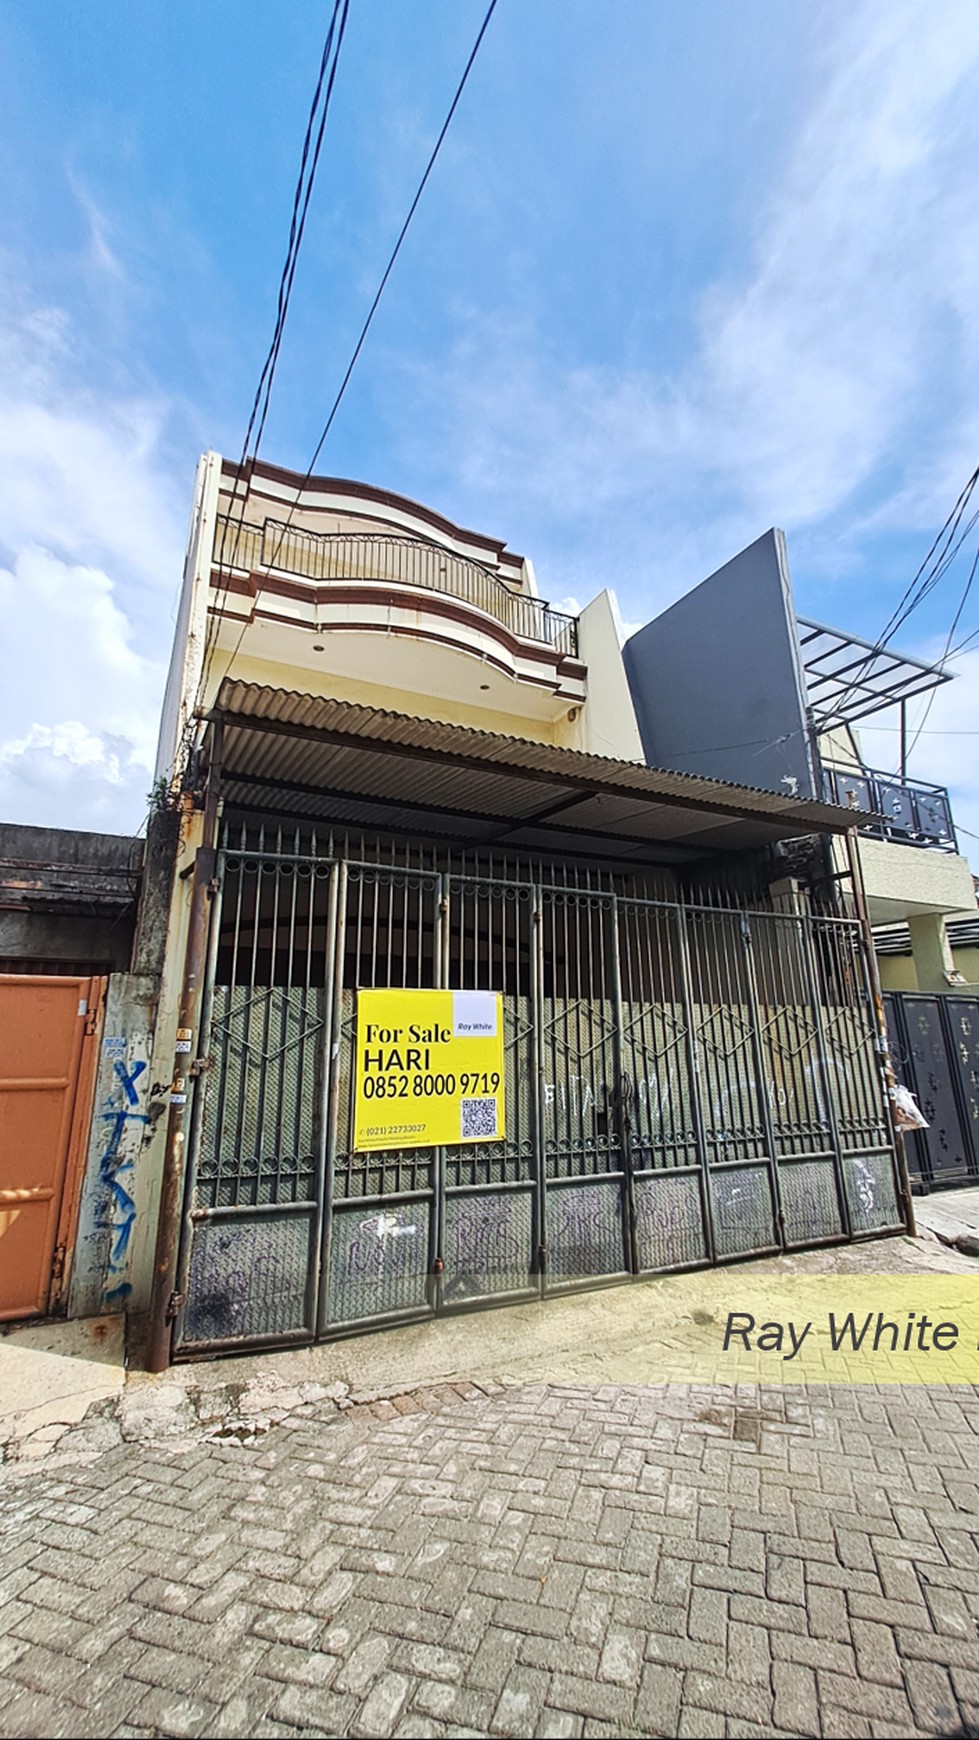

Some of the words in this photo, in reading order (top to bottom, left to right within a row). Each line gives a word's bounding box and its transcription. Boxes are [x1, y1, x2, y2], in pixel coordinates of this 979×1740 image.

[365, 1024, 403, 1044] For
[408, 1023, 451, 1043] Sale
[457, 1023, 472, 1031] Ray
[364, 1049, 429, 1072] HARI
[364, 1075, 408, 1099] 0852
[413, 1074, 455, 1097] 8000
[460, 1072, 500, 1095] 9719
[366, 1127, 387, 1136] (021)
